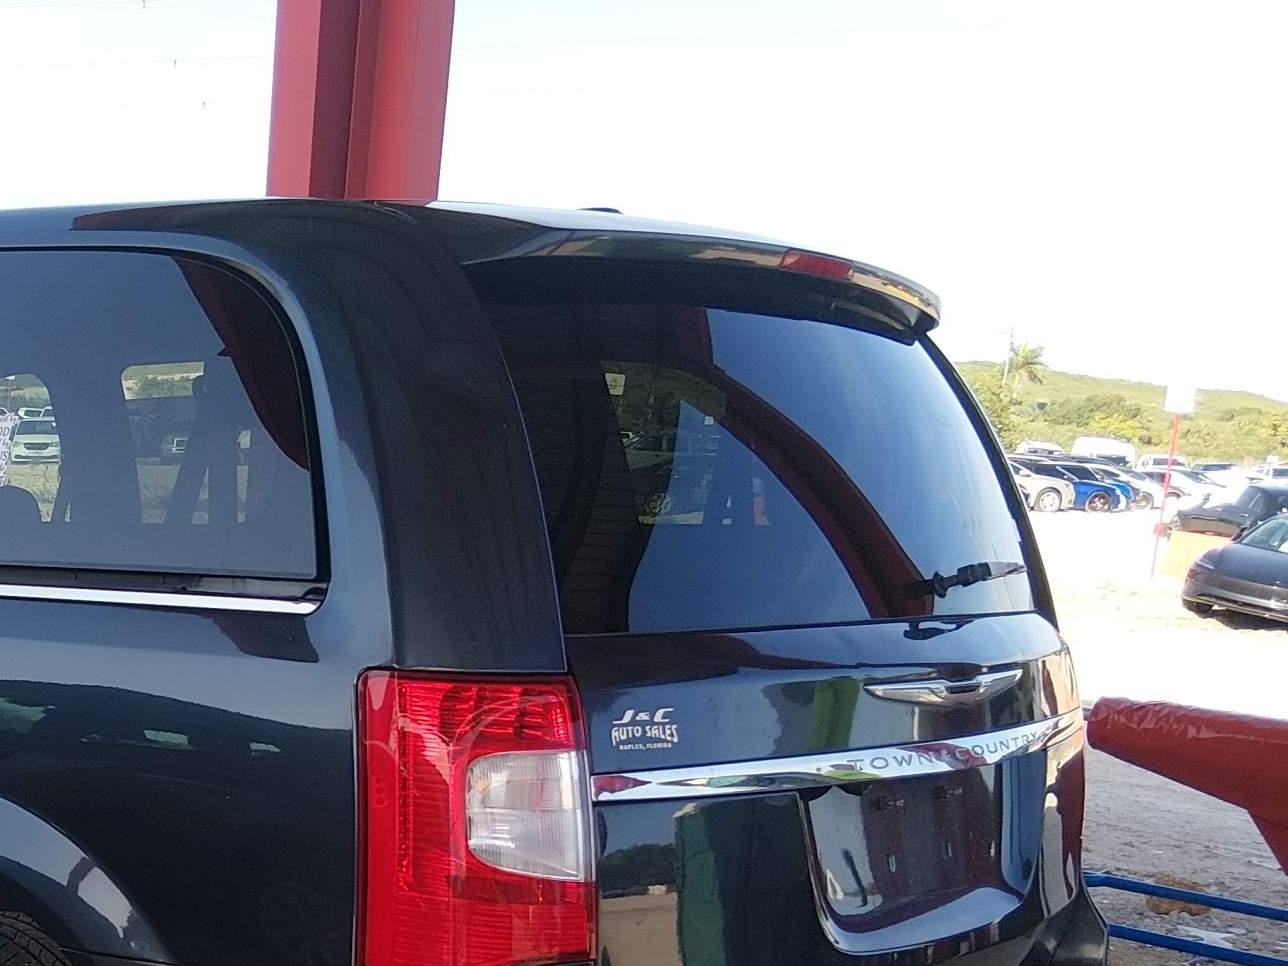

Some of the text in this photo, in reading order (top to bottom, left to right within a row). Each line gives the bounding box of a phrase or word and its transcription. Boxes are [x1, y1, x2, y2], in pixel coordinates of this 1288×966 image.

[611, 724, 679, 746] AUTO SALES
[847, 732, 1040, 772] TOWN & COUNTRY
